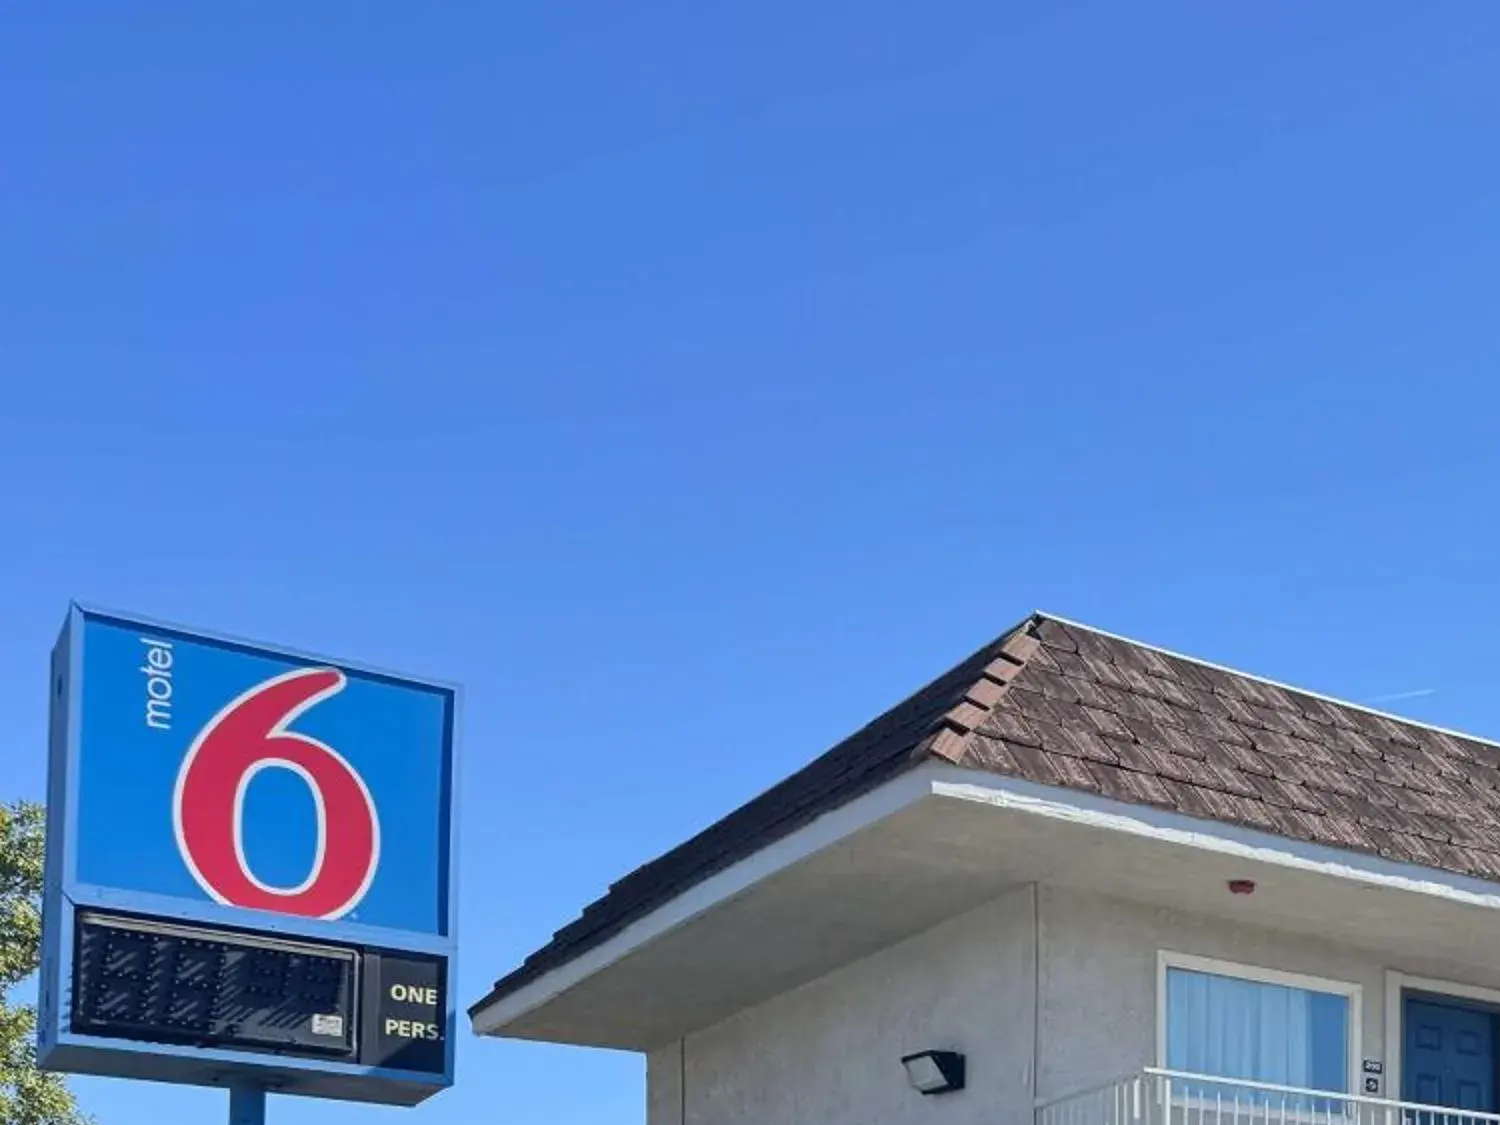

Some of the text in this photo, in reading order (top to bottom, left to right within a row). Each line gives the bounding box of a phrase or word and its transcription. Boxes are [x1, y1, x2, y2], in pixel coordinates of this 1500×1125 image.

[140, 637, 173, 729] motel
[173, 665, 381, 921] 6
[391, 984, 437, 1005] ONE
[385, 1017, 444, 1041] PERS.
